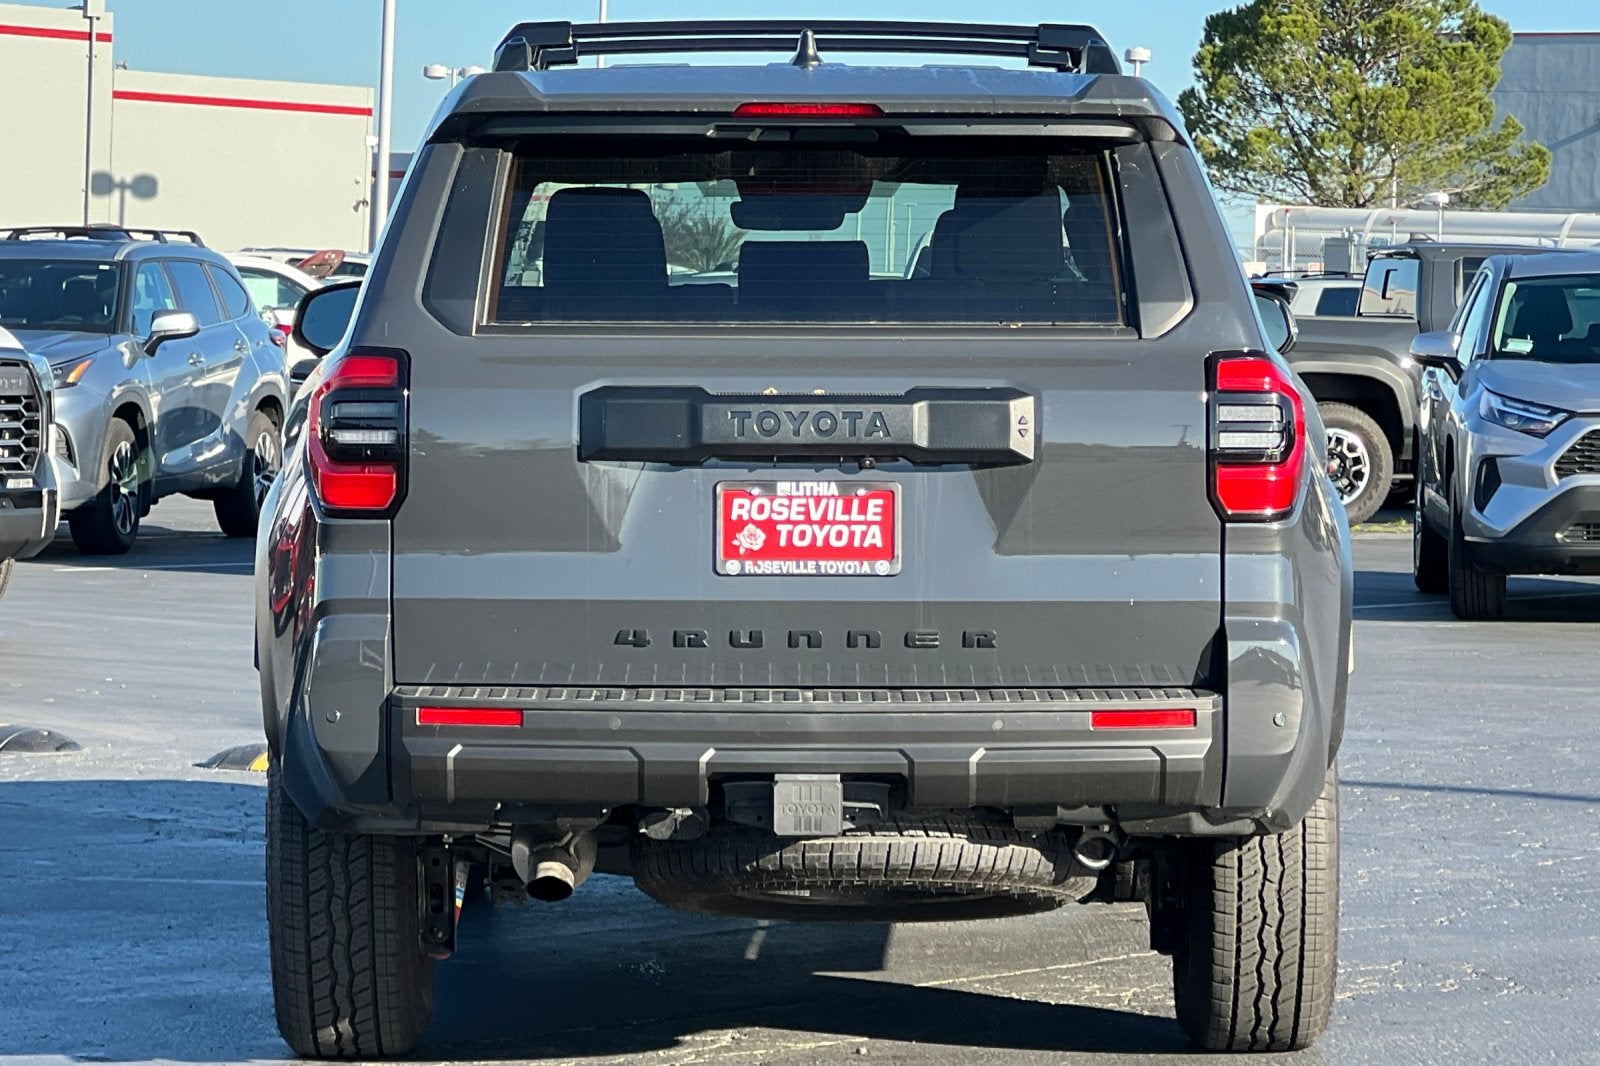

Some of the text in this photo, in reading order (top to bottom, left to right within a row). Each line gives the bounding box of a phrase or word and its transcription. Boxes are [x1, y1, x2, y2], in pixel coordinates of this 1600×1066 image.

[728, 410, 891, 437] TOYOTA
[790, 482, 839, 496] LITHIA
[730, 498, 884, 521] ROSEVILLE
[776, 524, 883, 547] TOYOTA
[779, 803, 836, 816] TOYOTA
